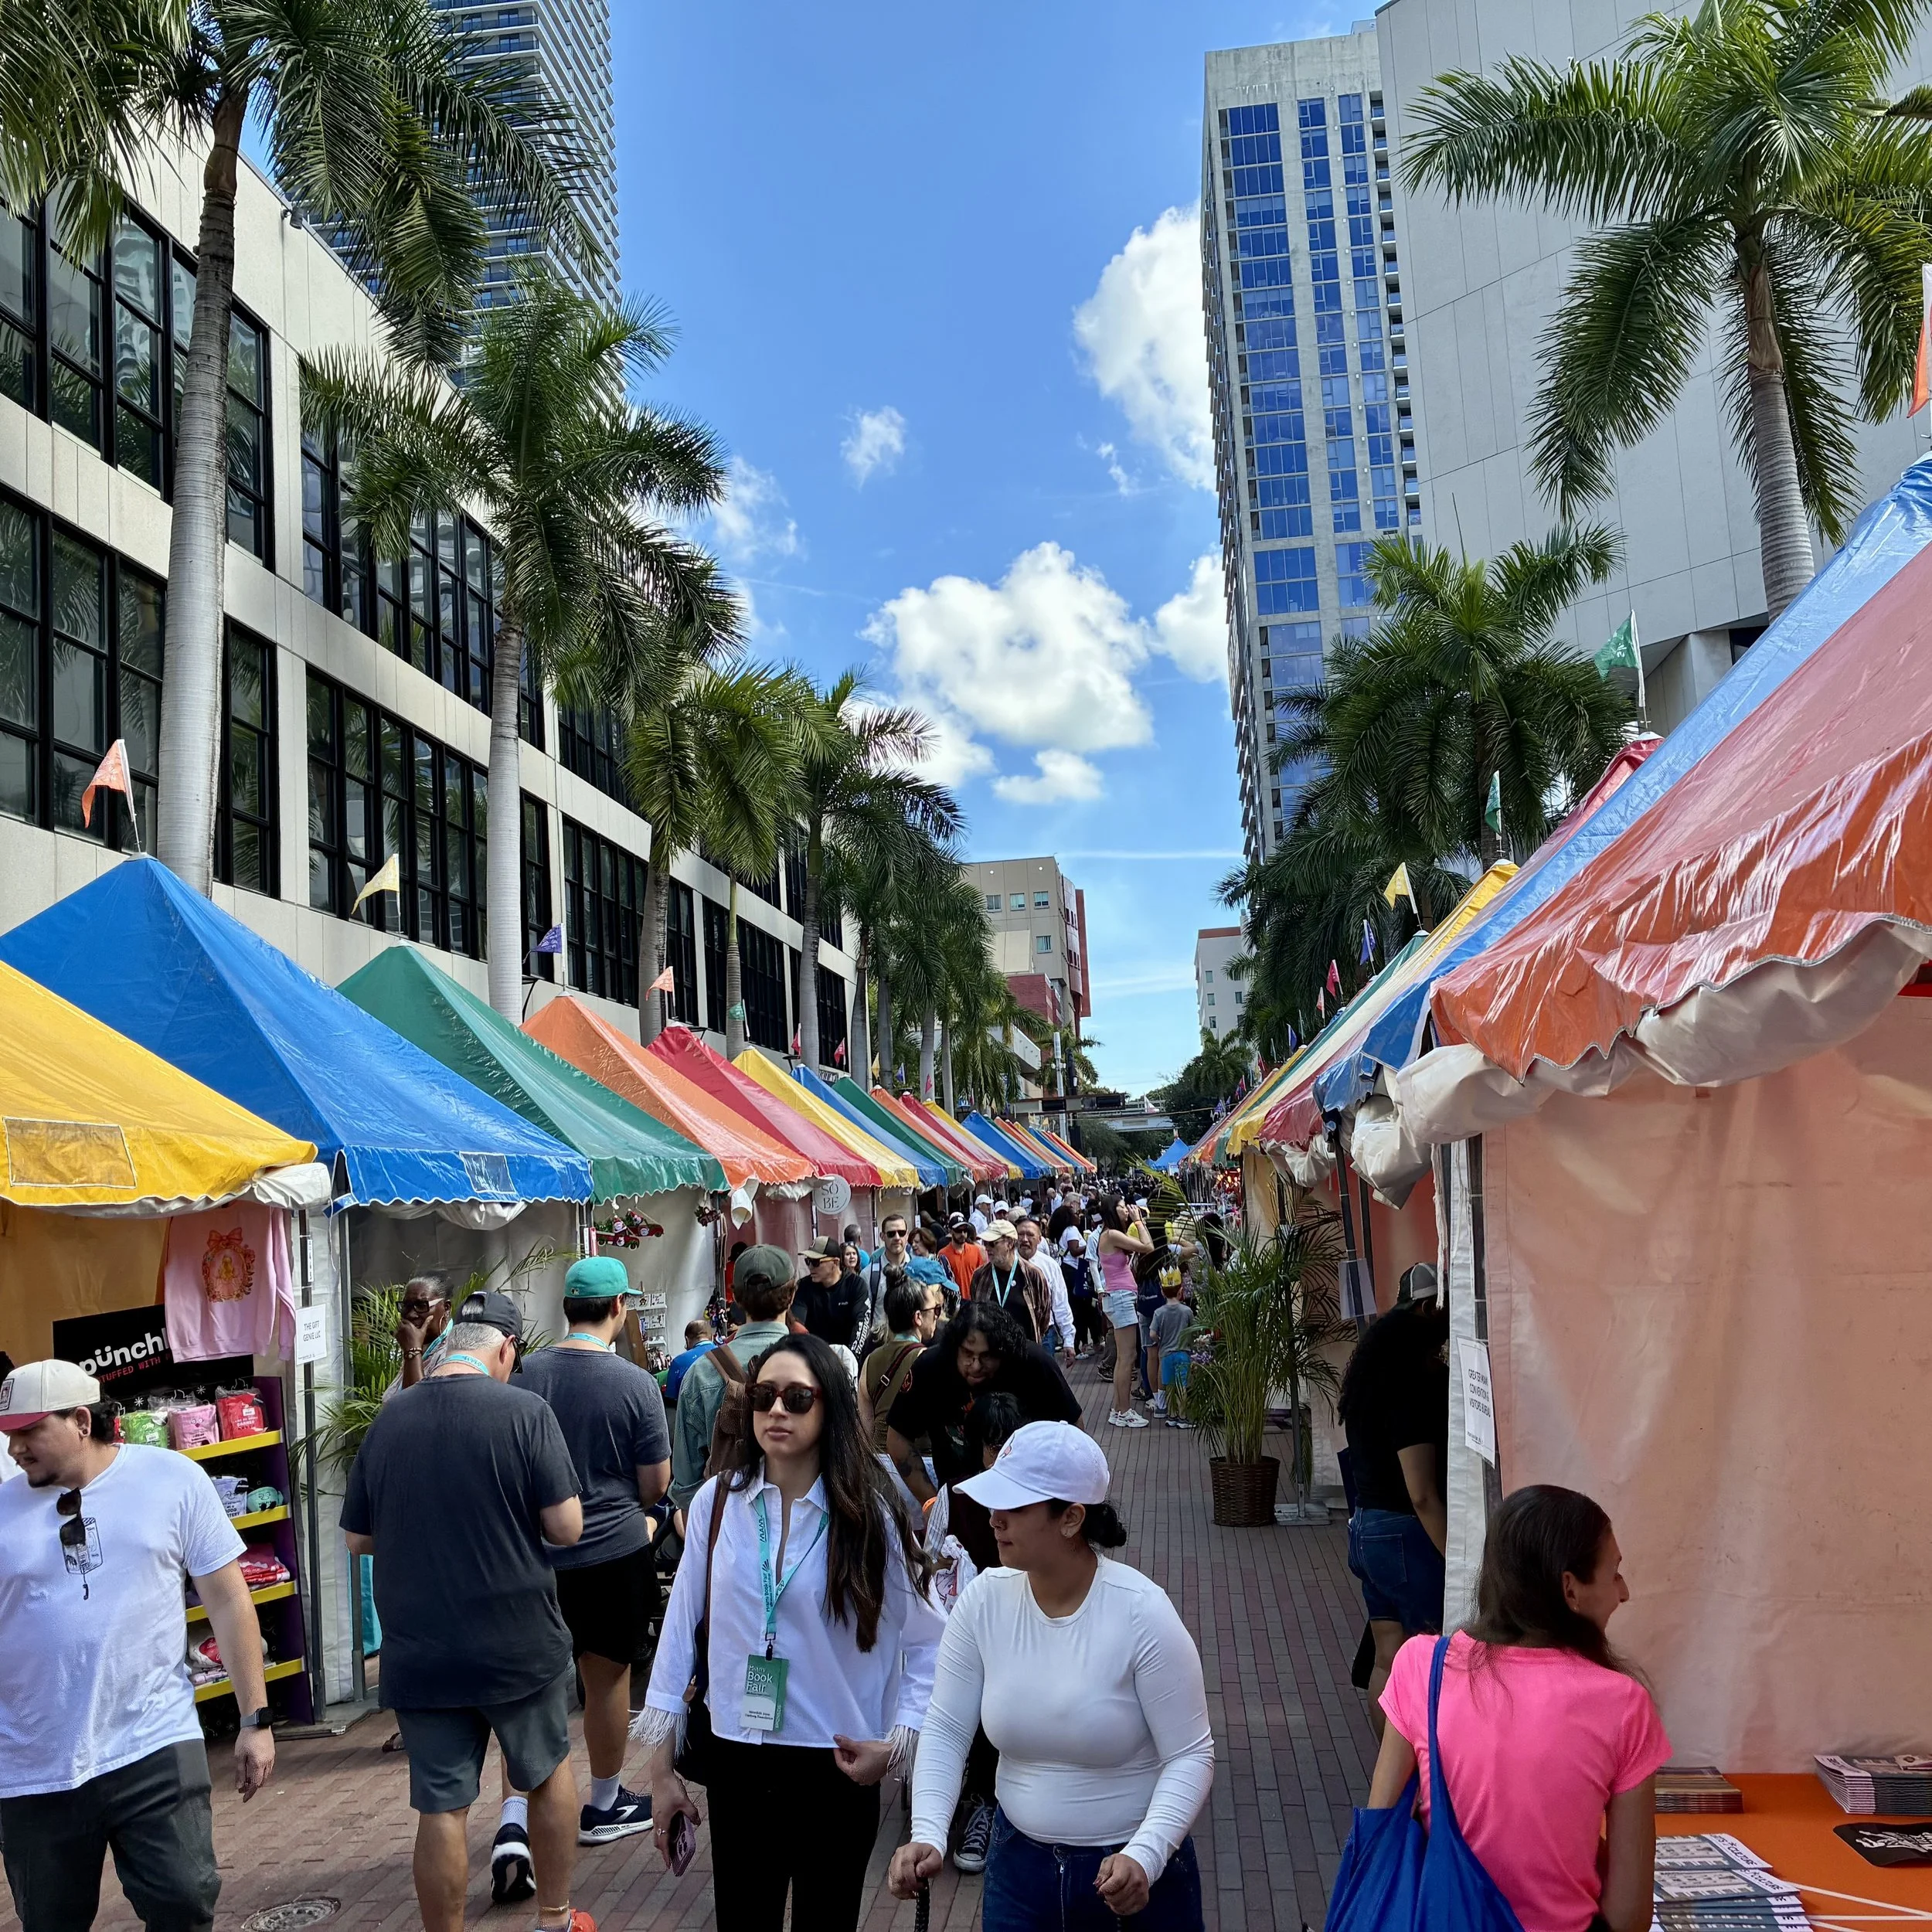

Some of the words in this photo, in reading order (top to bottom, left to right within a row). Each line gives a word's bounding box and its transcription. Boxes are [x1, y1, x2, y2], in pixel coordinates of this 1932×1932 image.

[823, 1197, 839, 1209] BE
[138, 1356, 161, 1369] WITH
[748, 1672, 773, 1683] Book
[747, 1681, 767, 1692] Fair
